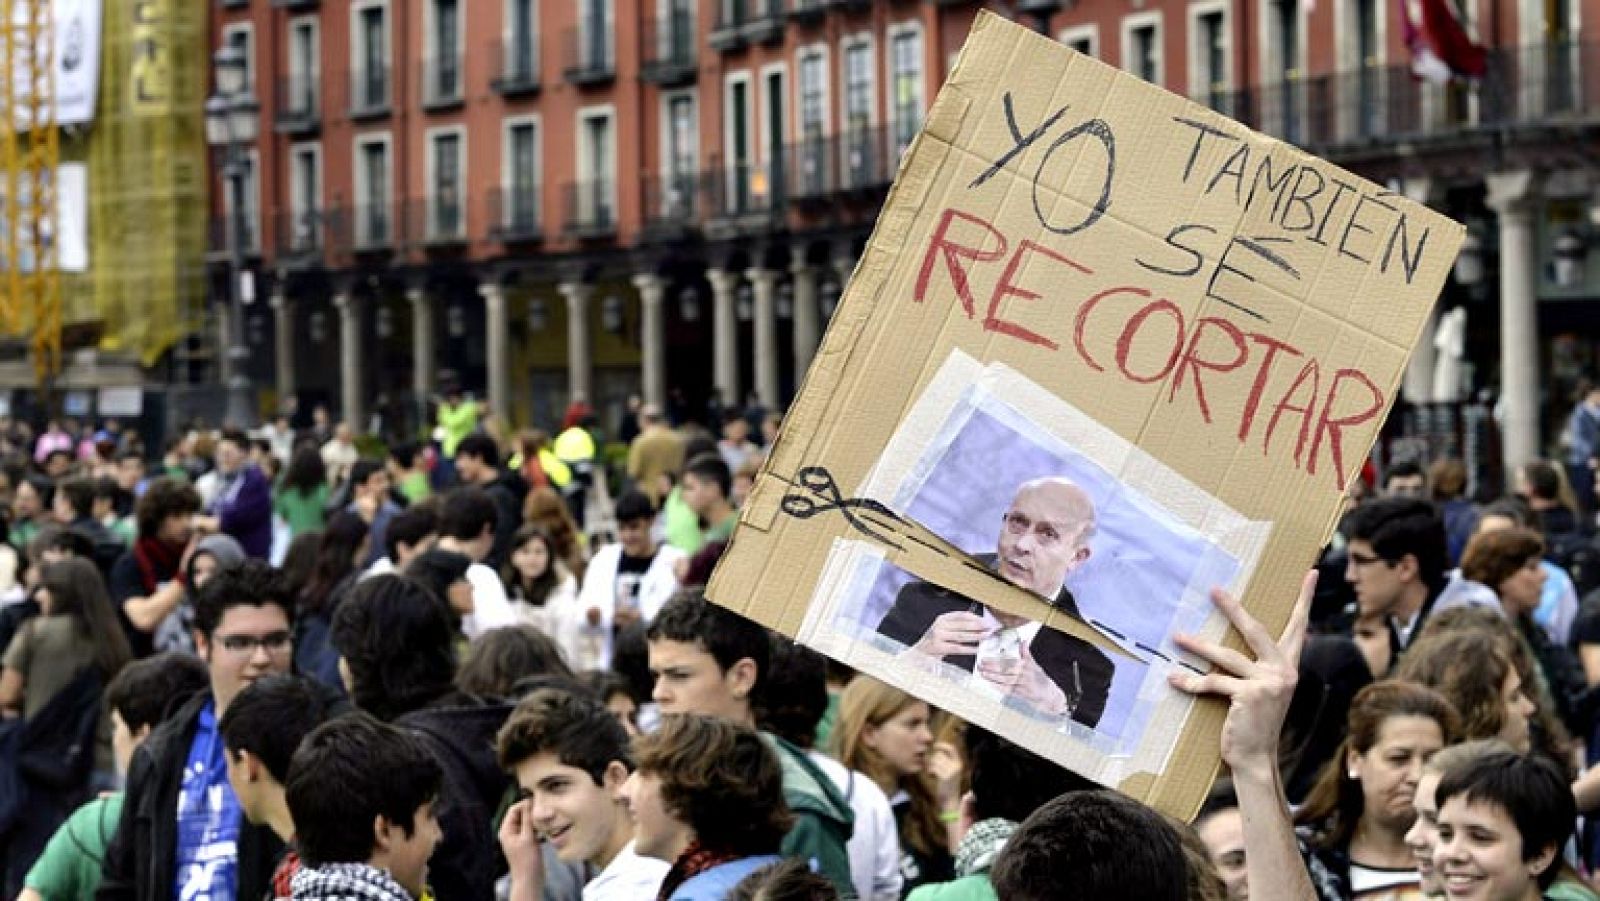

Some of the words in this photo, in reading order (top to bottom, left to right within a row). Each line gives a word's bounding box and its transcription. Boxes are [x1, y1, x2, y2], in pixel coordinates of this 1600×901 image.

[968, 91, 1117, 235] YO
[1172, 116, 1430, 285] TAMBIÉN
[1135, 224, 1301, 323] SÉ
[913, 208, 1385, 492] RECORTAR
